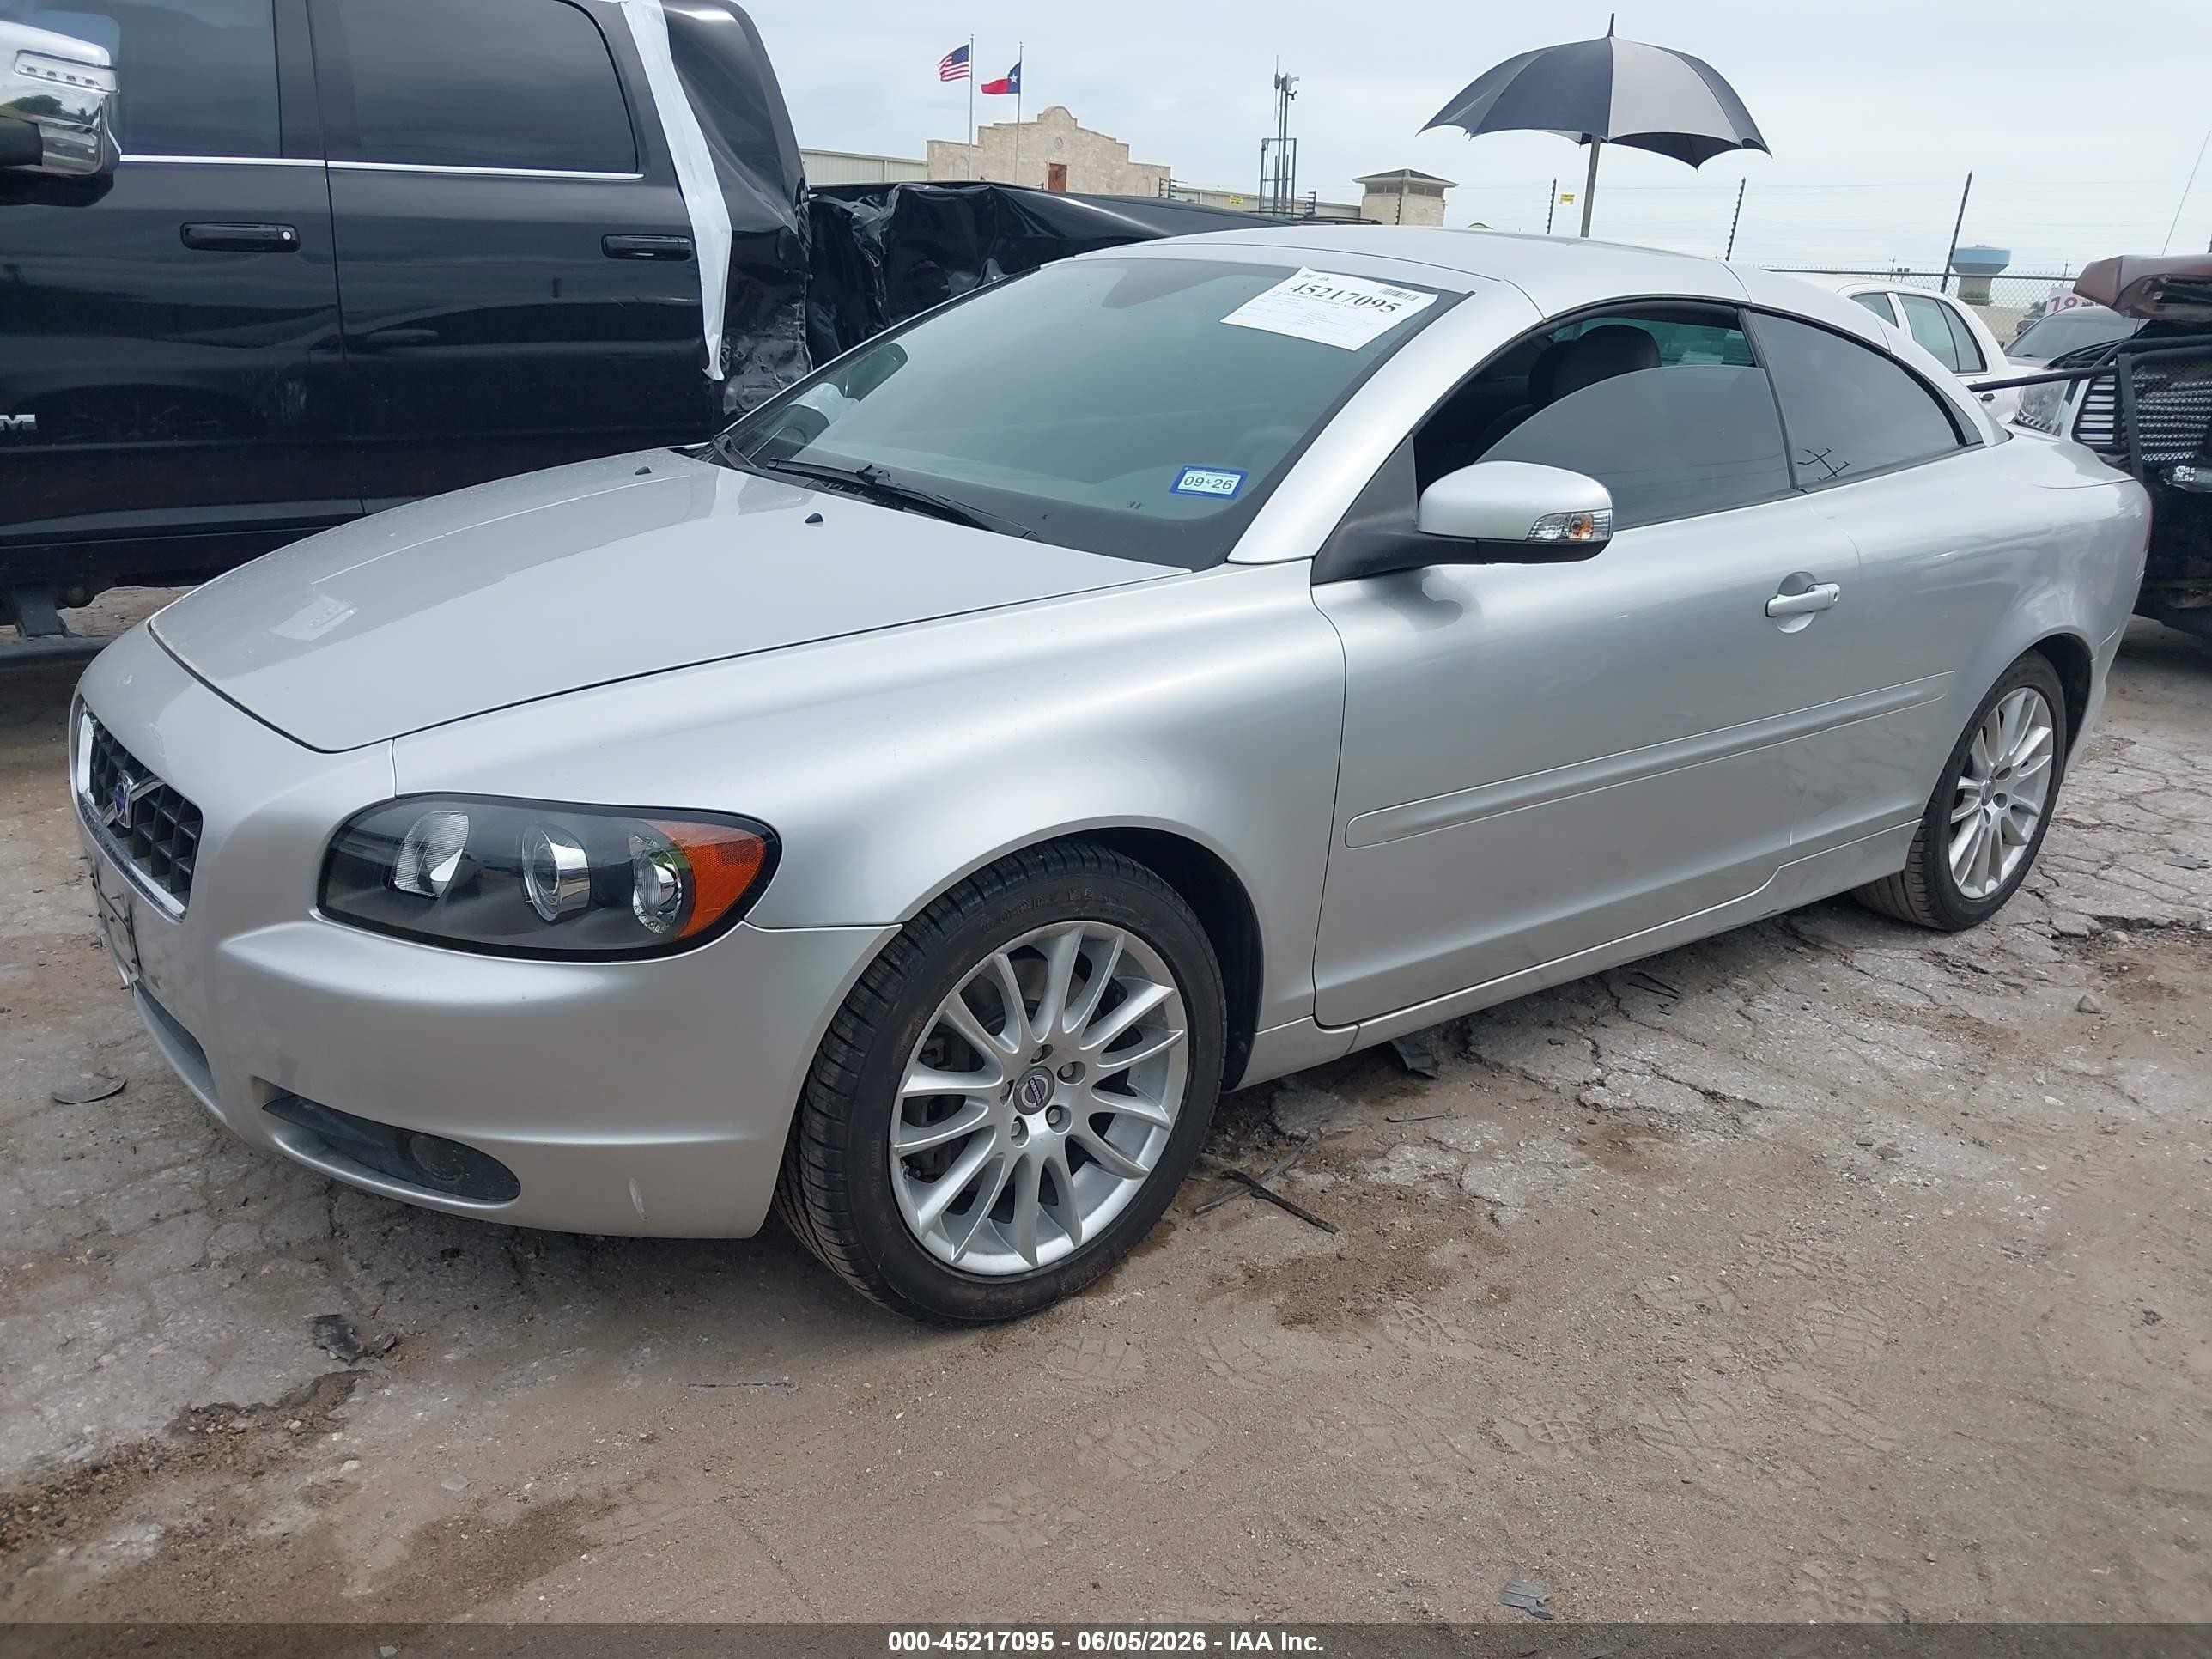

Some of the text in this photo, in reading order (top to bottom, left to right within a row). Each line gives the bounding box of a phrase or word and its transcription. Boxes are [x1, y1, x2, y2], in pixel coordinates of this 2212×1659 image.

[1289, 283, 1402, 313] 45217095
[1183, 476, 1234, 489] 09 26
[1030, 1079, 1042, 1104] VOLVO
